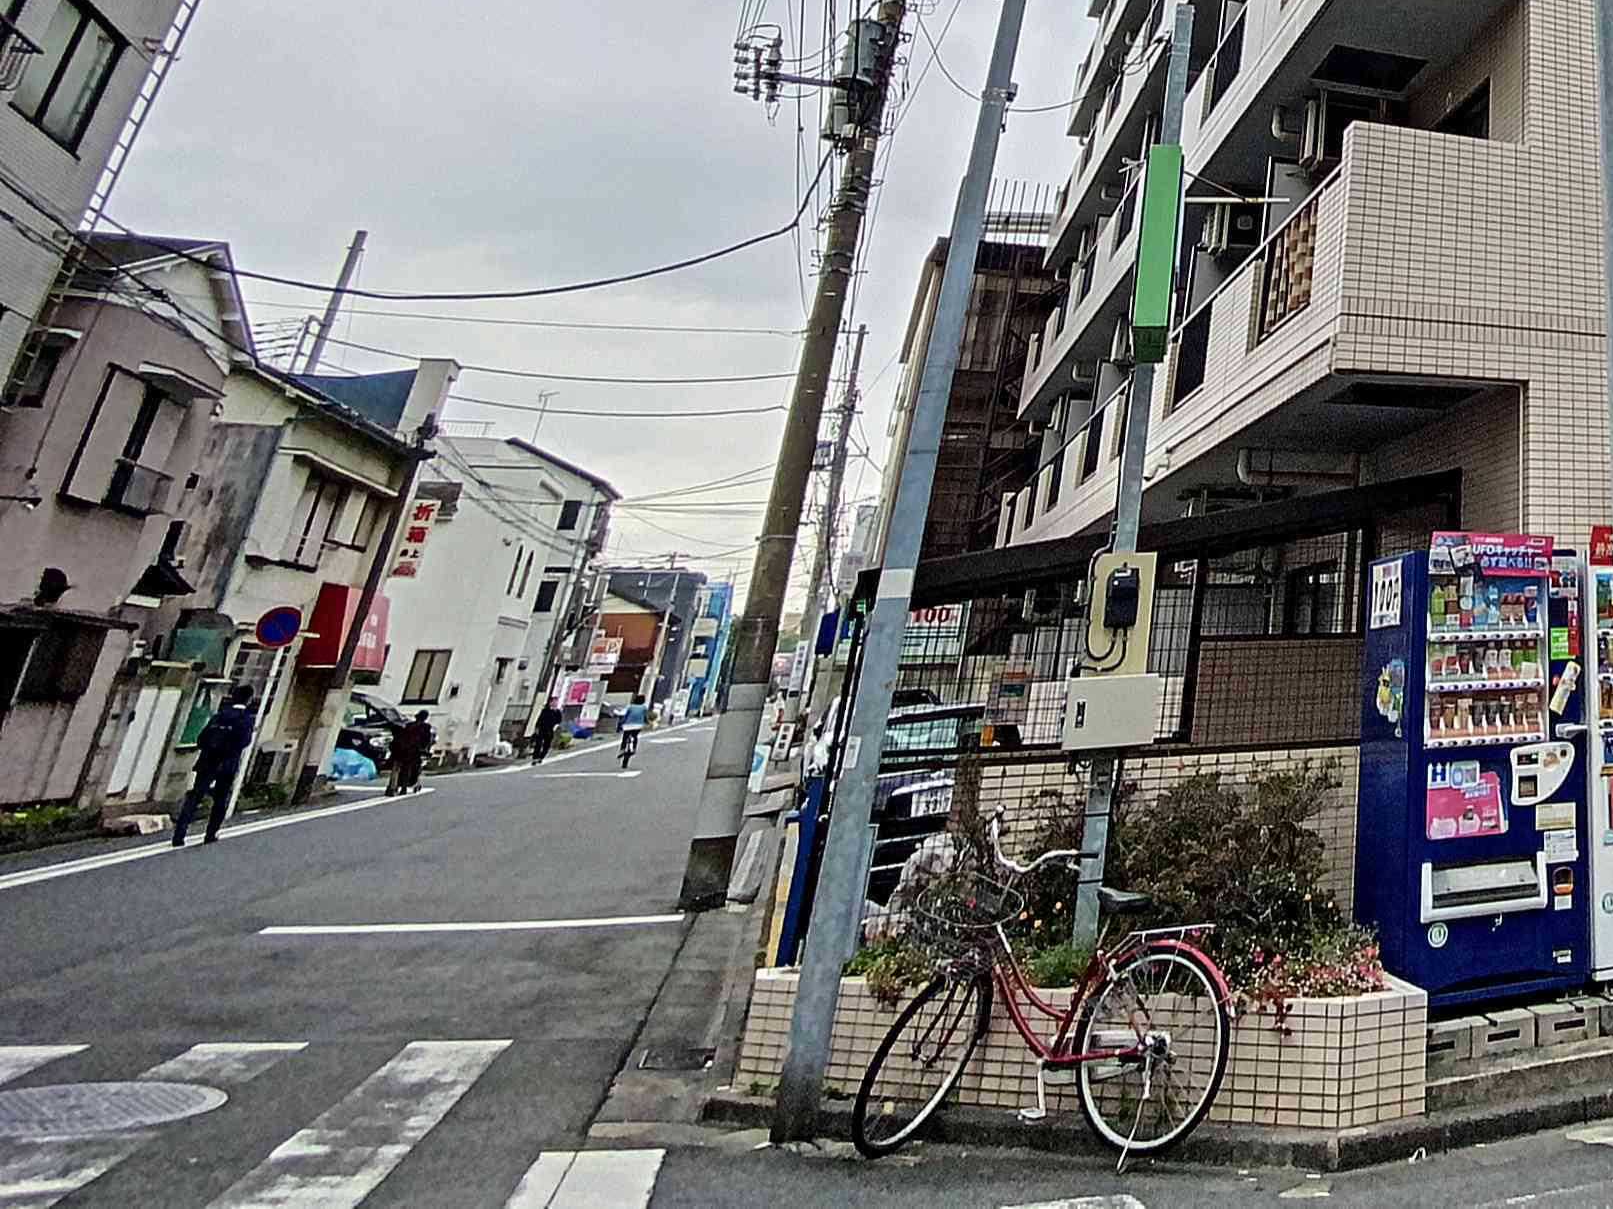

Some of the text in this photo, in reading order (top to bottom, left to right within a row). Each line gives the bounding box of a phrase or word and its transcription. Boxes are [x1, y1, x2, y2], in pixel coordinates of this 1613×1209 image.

[1472, 544, 1543, 556] UFOキャッチャー
